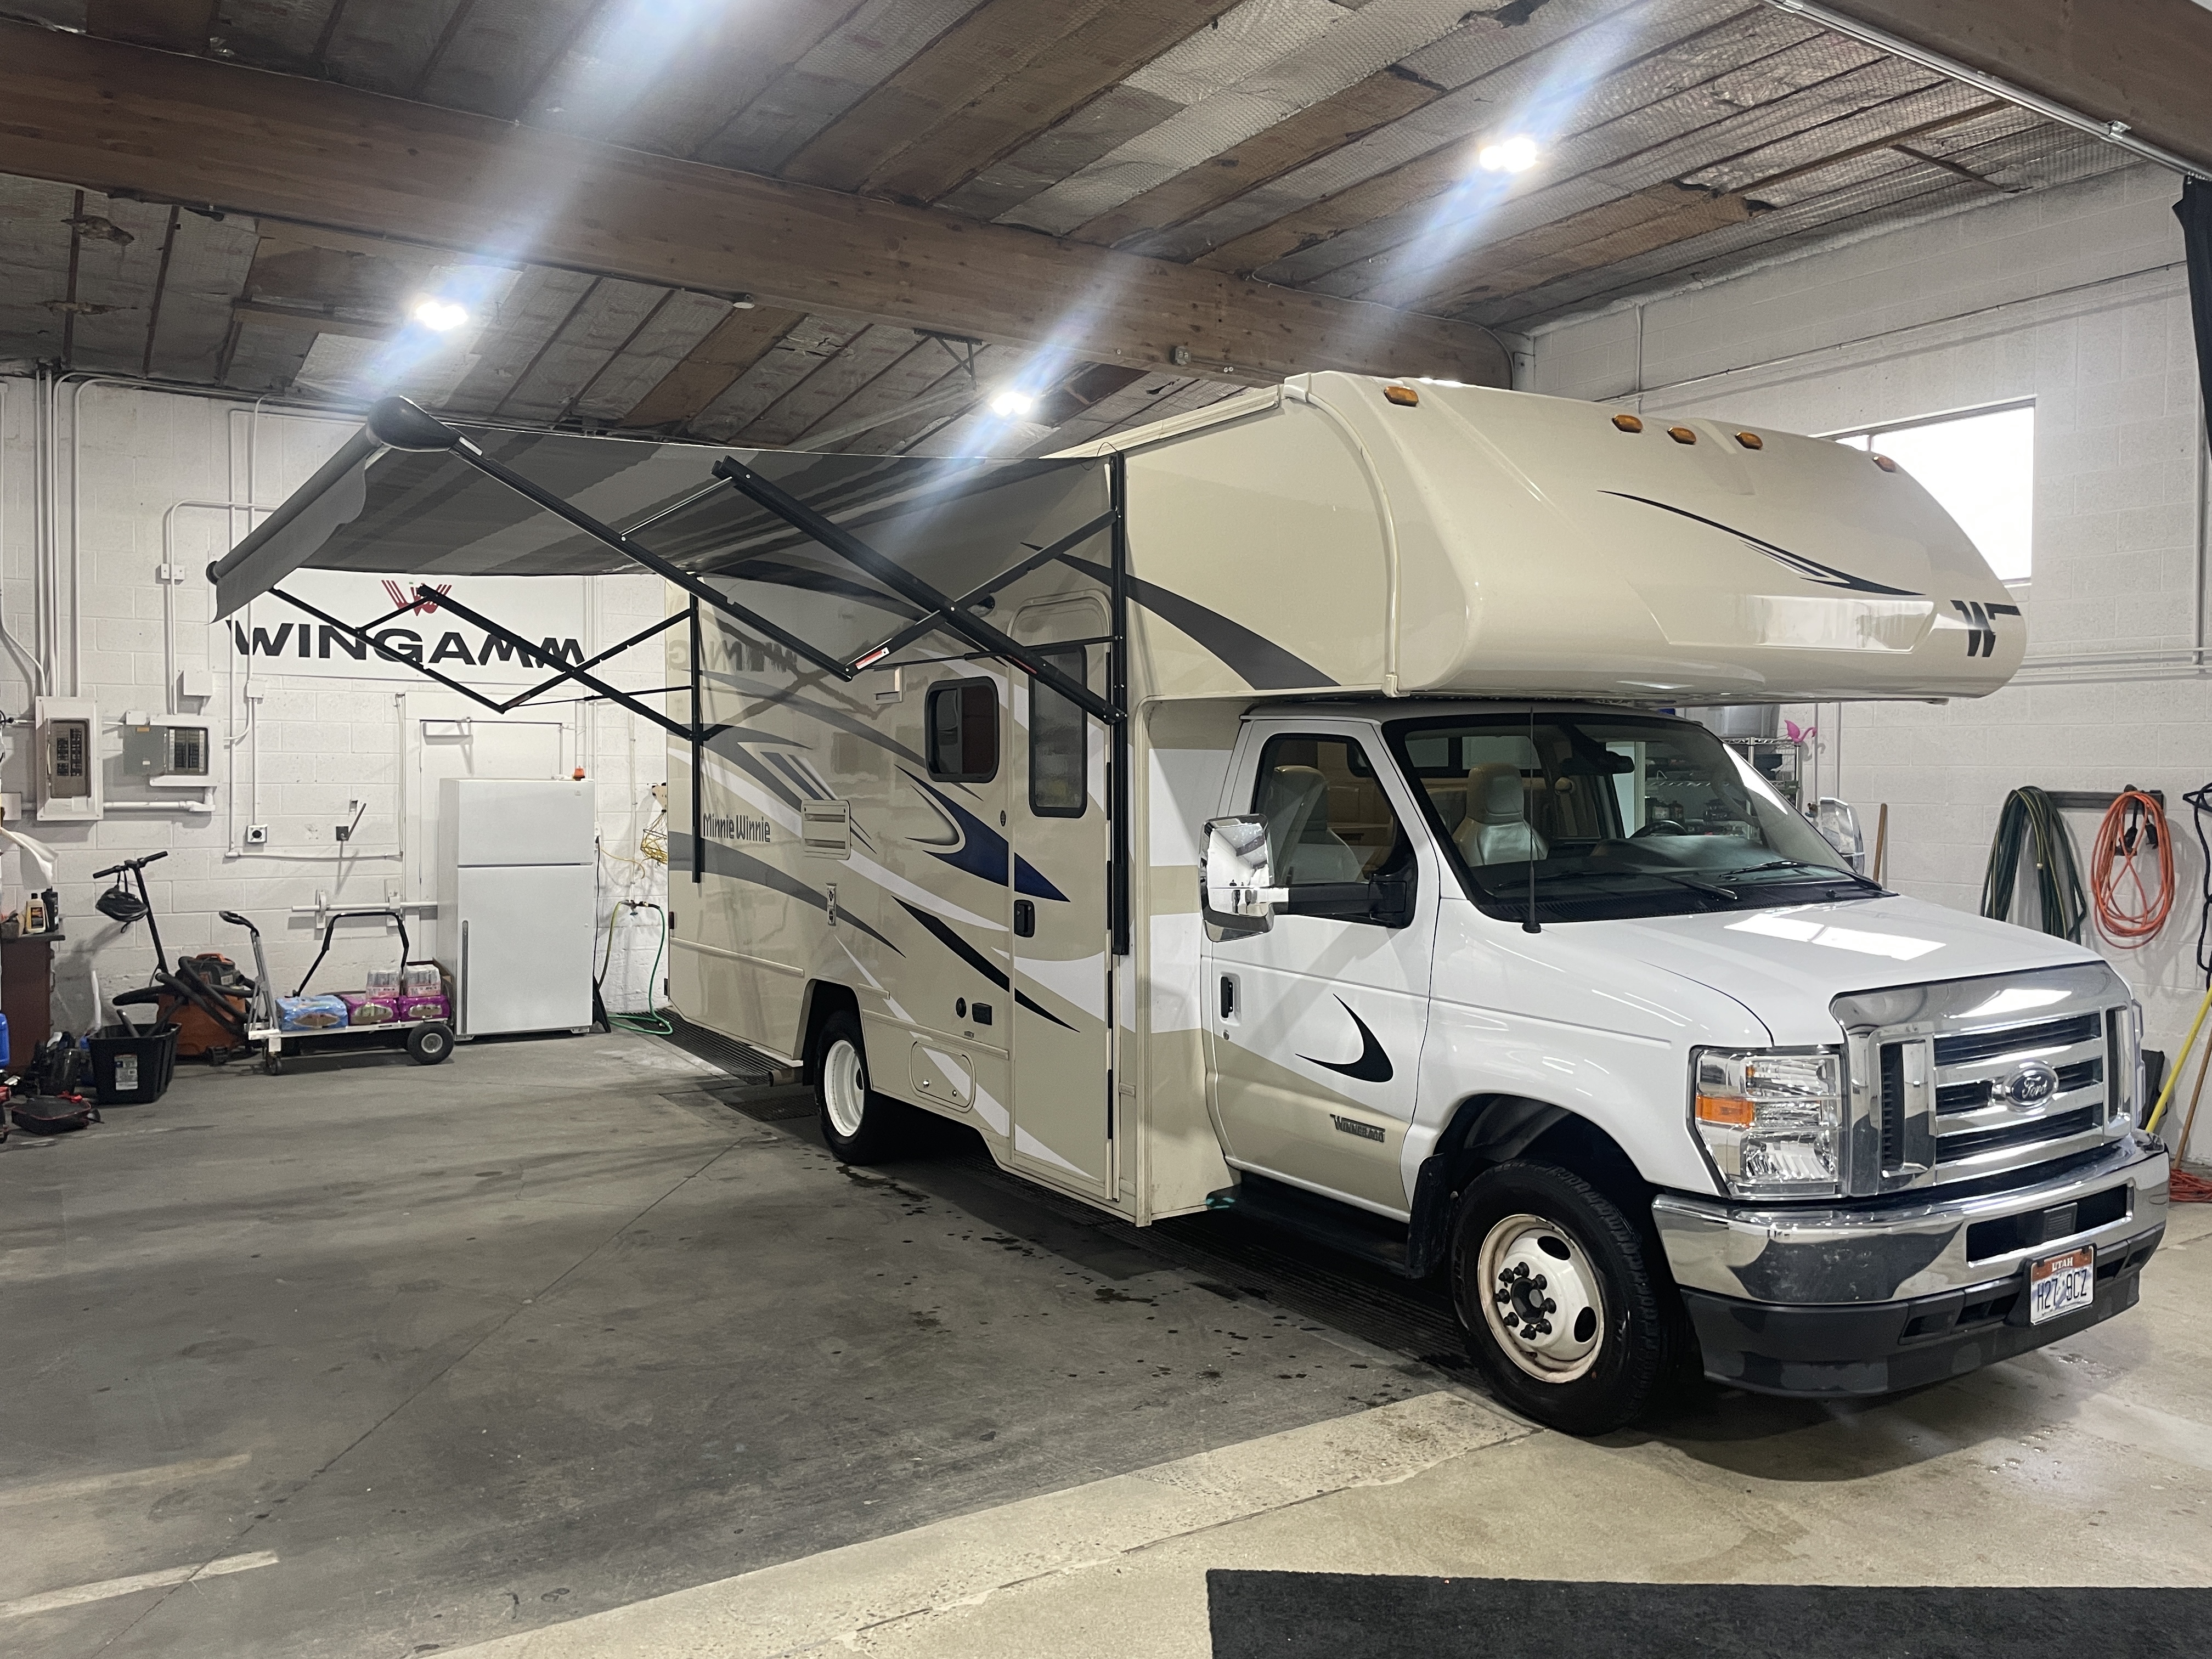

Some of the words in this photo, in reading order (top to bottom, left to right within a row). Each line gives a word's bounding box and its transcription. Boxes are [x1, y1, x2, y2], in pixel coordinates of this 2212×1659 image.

[225, 620, 585, 668] WINGAMM
[703, 812, 734, 839] Minnie
[736, 815, 770, 843] Winnie
[2022, 1076, 2047, 1099] Ford
[2052, 1257, 2073, 1272] UTAH
[2037, 1278, 2058, 1312] H27
